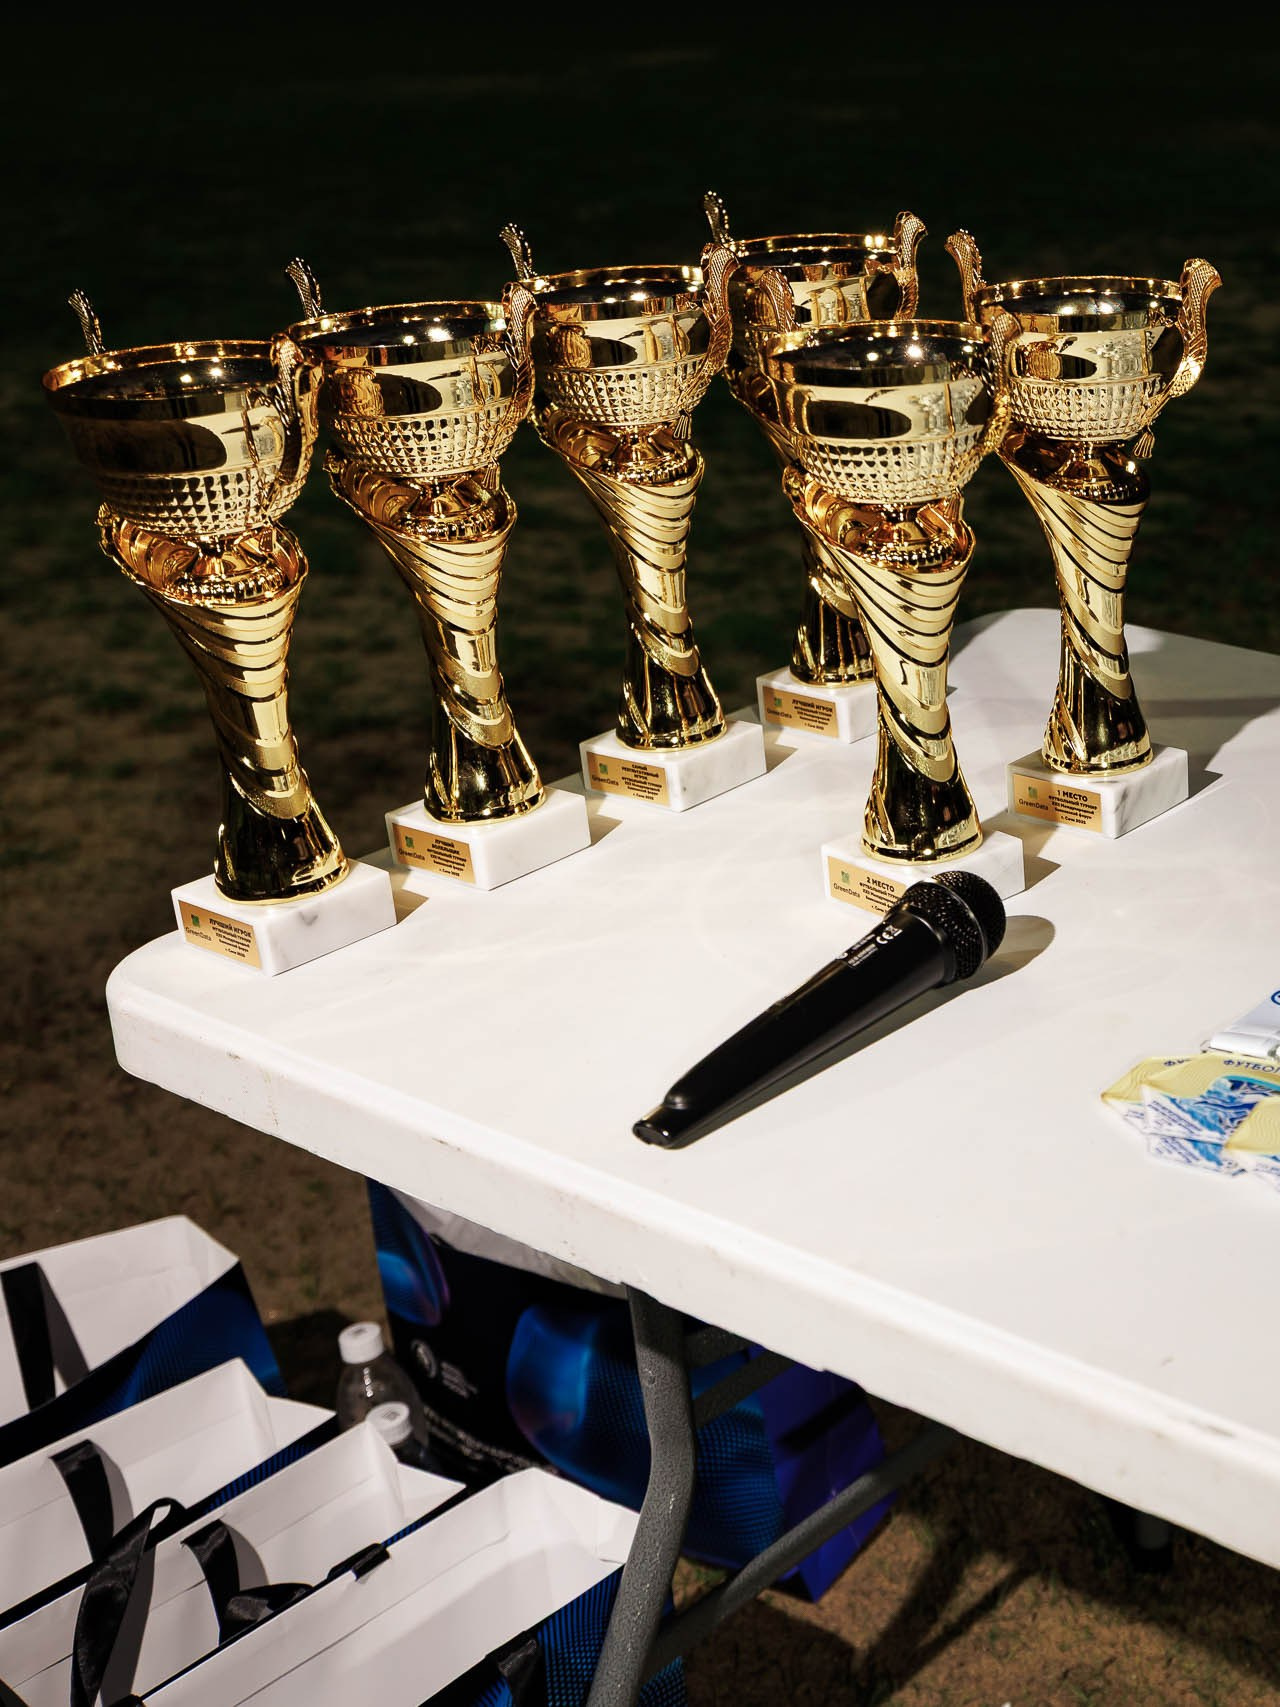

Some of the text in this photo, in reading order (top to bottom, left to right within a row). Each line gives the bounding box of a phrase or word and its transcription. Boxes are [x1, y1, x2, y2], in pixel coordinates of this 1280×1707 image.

[1062, 790, 1087, 802] МЕСТО
[1018, 797, 1048, 811] GreenData
[833, 882, 860, 899] GreenData
[871, 878, 894, 892] МЕСТО
